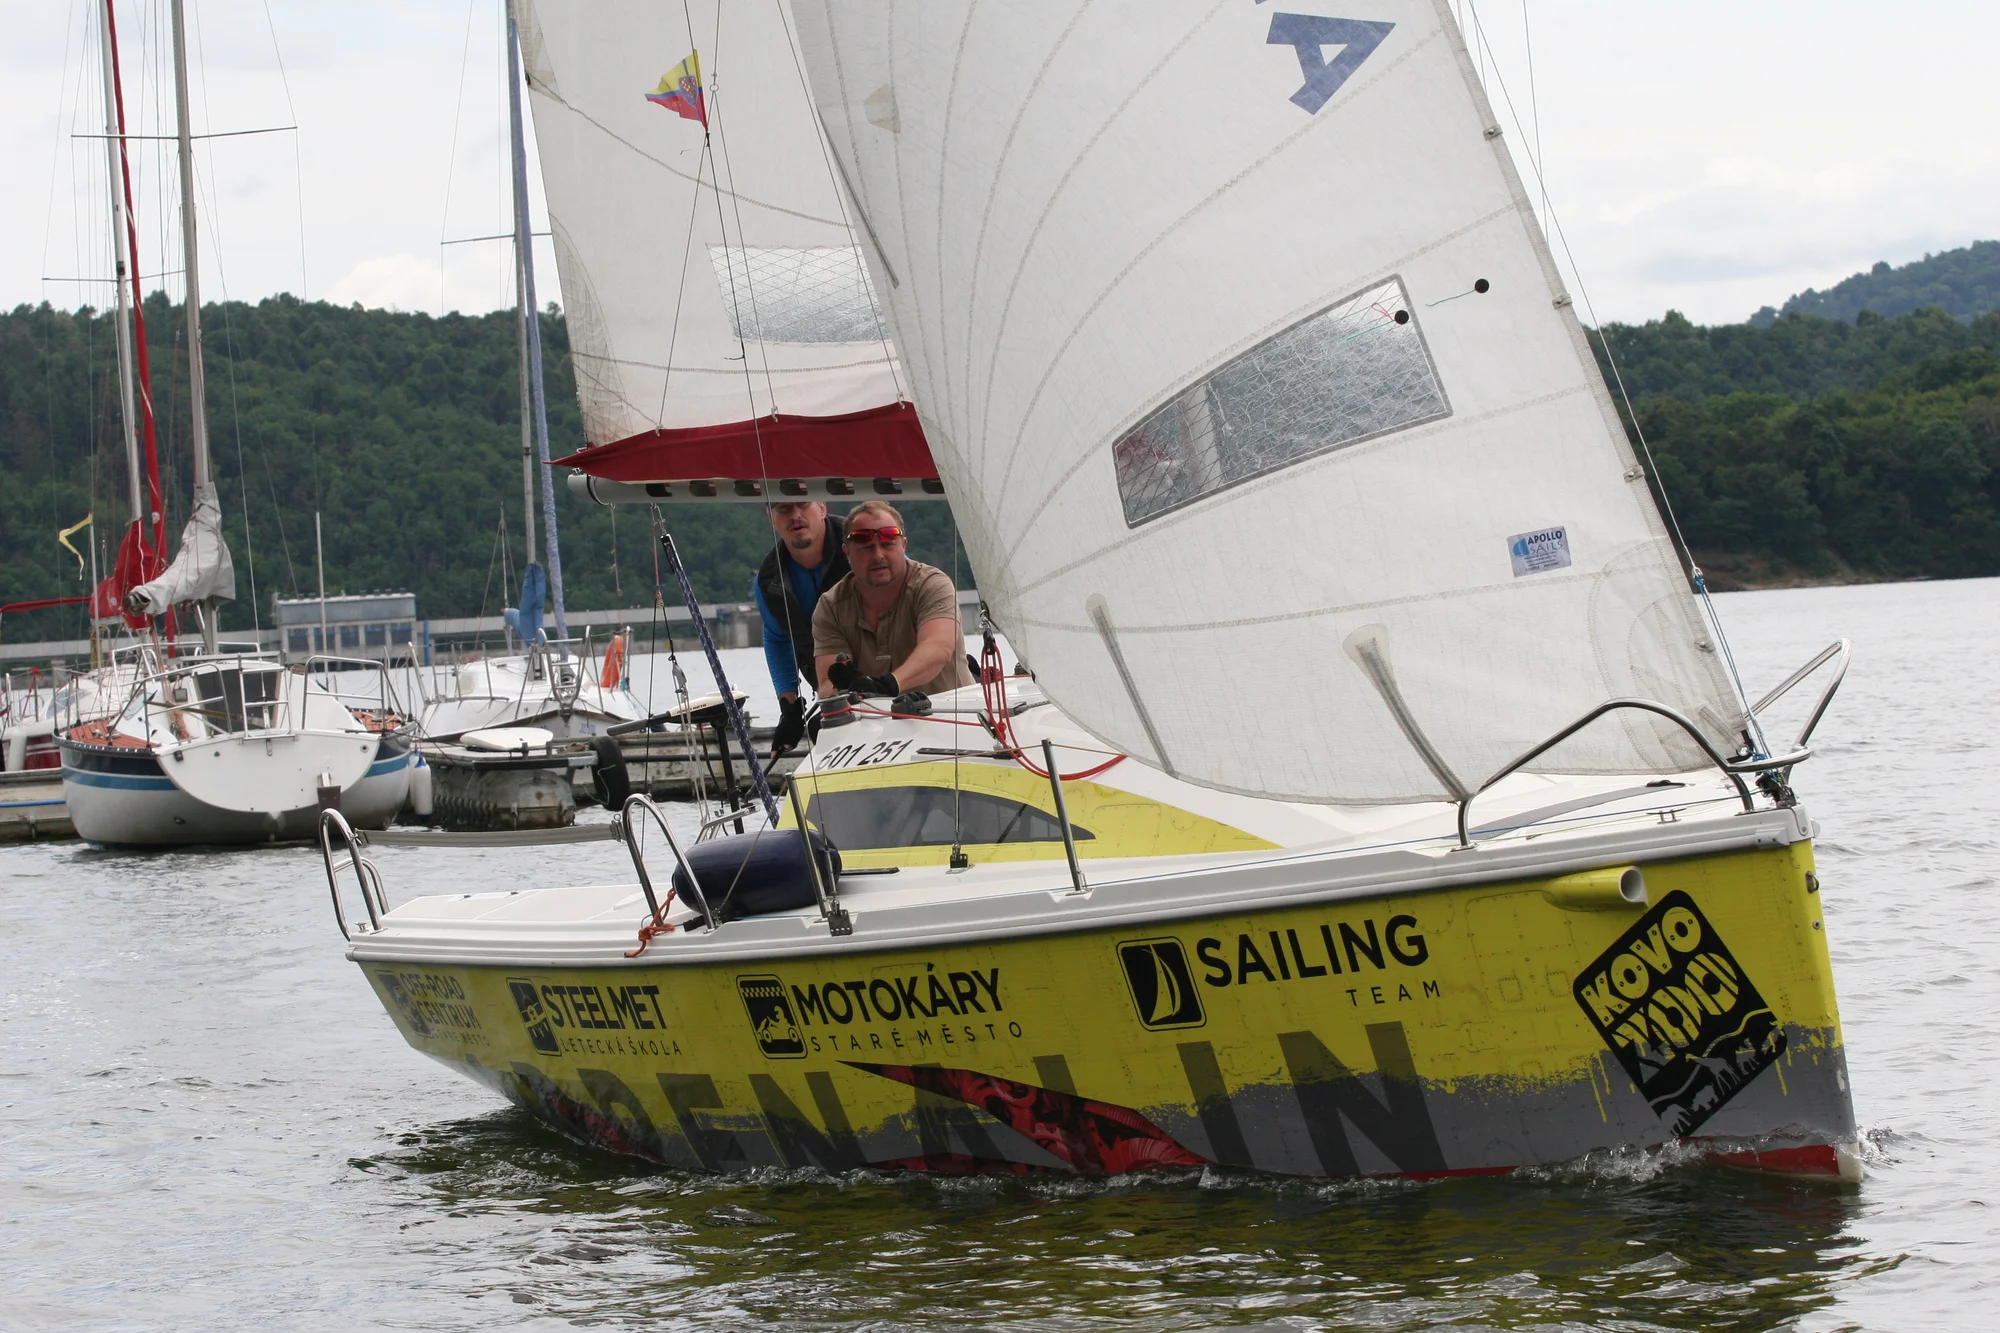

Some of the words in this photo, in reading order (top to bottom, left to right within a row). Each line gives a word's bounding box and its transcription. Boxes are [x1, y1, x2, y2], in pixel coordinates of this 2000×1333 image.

[1255, 0, 1397, 116] A
[1527, 530, 1563, 545] APOLLO
[1529, 540, 1563, 555] SAILS
[815, 743, 867, 771] 601
[857, 738, 914, 766] 251
[1196, 914, 1429, 988] SAILING
[1581, 906, 1701, 1027] KOVO
[400, 973, 466, 1001] OFF-ROAD
[790, 961, 1003, 1026] MOTOKÁRY
[1345, 980, 1441, 1007] TEAM
[416, 1000, 482, 1030] CENTRUM
[541, 984, 667, 1030] STEELMET
[560, 1036, 626, 1055] LETECKÁ
[627, 1036, 683, 1056] ŠKOLA
[811, 1027, 909, 1052] STARÉ
[917, 1021, 1023, 1046] MĚSTO
